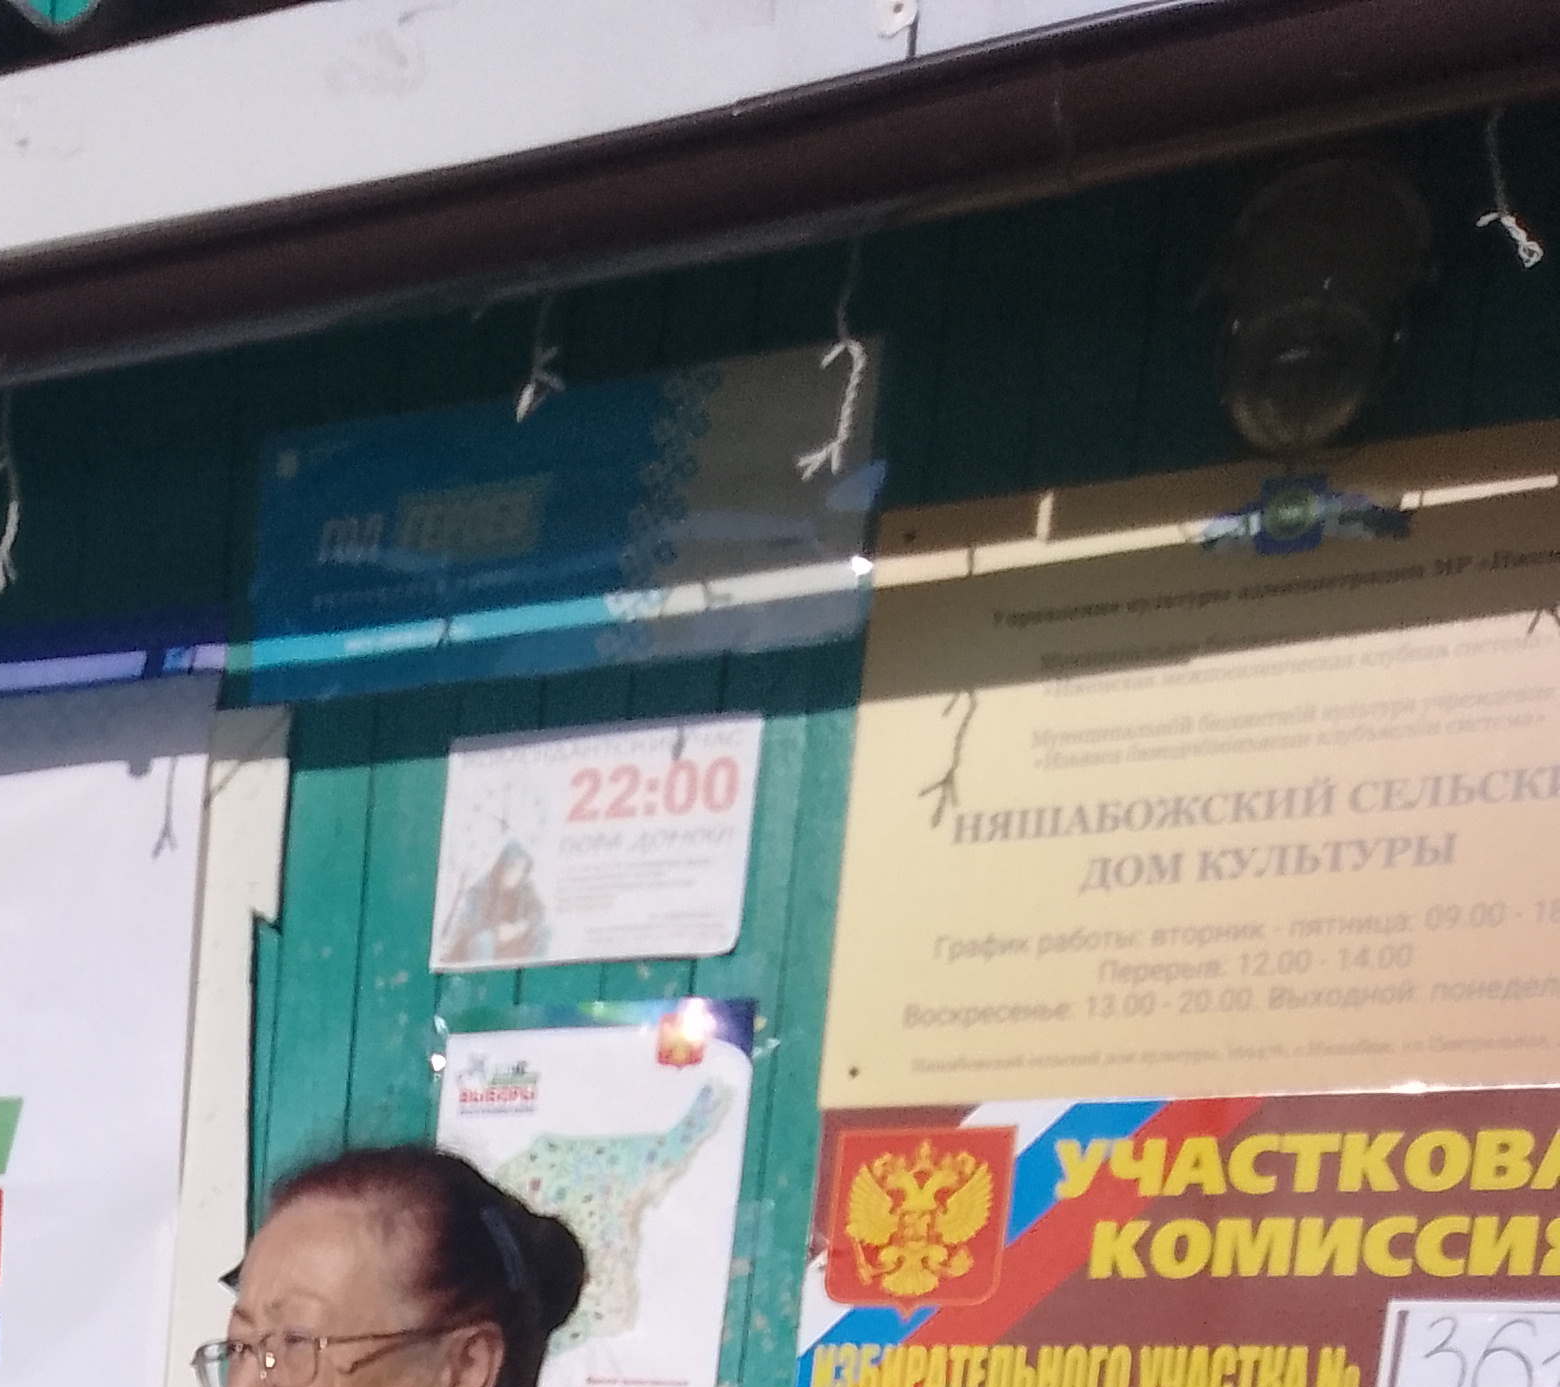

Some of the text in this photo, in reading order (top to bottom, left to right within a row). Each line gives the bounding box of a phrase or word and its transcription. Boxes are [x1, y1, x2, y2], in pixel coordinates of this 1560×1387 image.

[565, 756, 738, 823] 22:00
[950, 776, 1336, 846] НЯШАБОЖСКИЙ
[1079, 833, 1457, 896] ДОМ КУЛЬТУРЫ
[933, 931, 1029, 965] График
